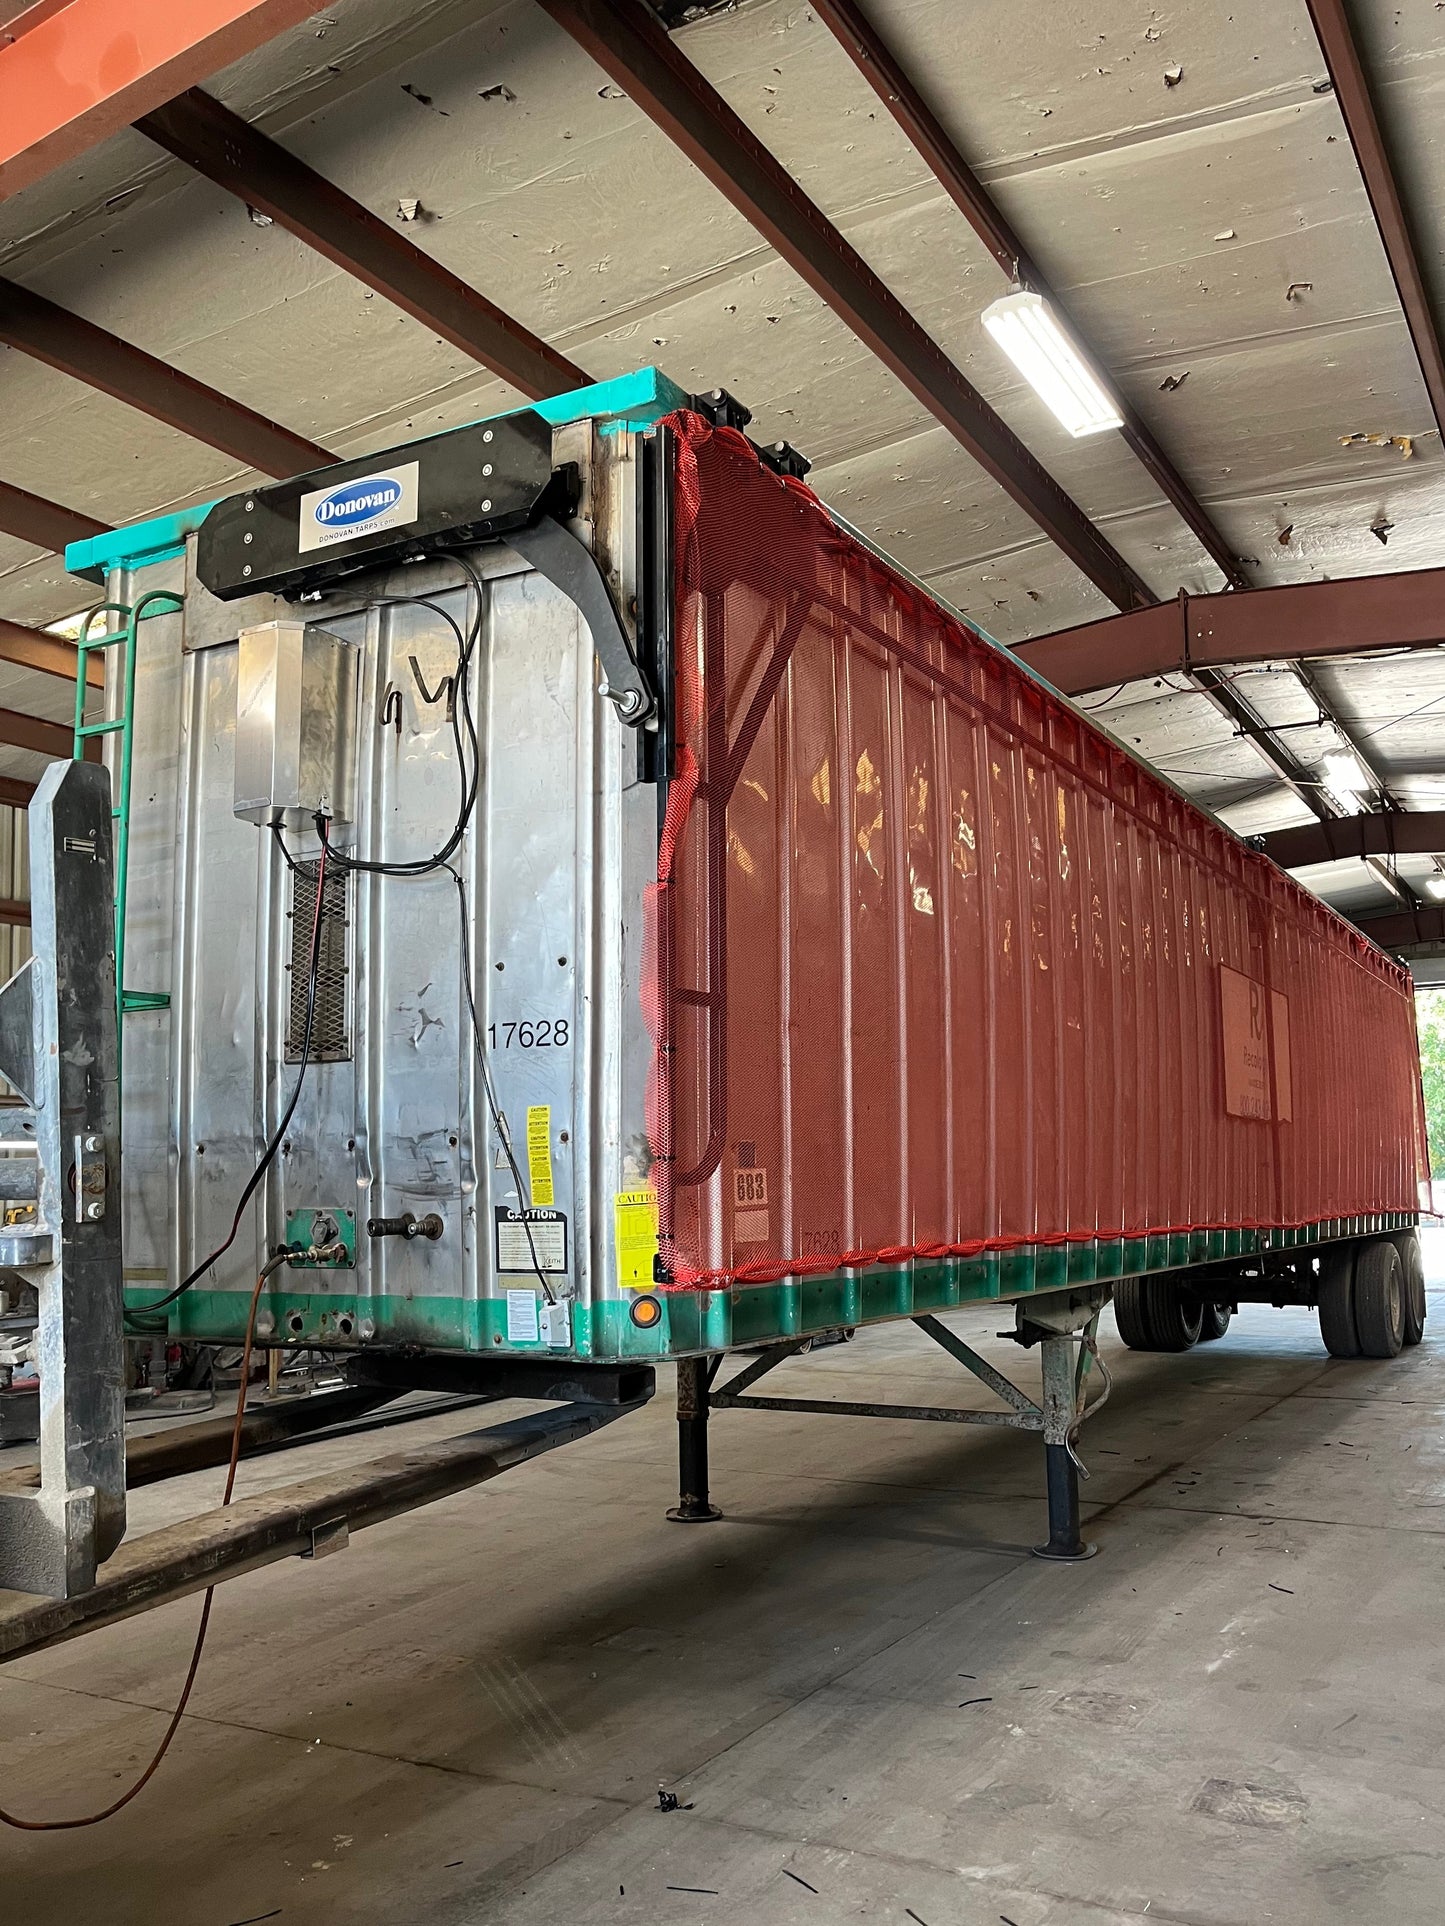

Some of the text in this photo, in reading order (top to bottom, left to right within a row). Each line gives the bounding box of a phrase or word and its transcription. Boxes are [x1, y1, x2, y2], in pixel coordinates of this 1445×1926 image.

[319, 488, 396, 521] Donovan
[319, 528, 353, 543] DONOVAN
[488, 1019, 569, 1049] 17628
[618, 1193, 657, 1203] CAUTIO
